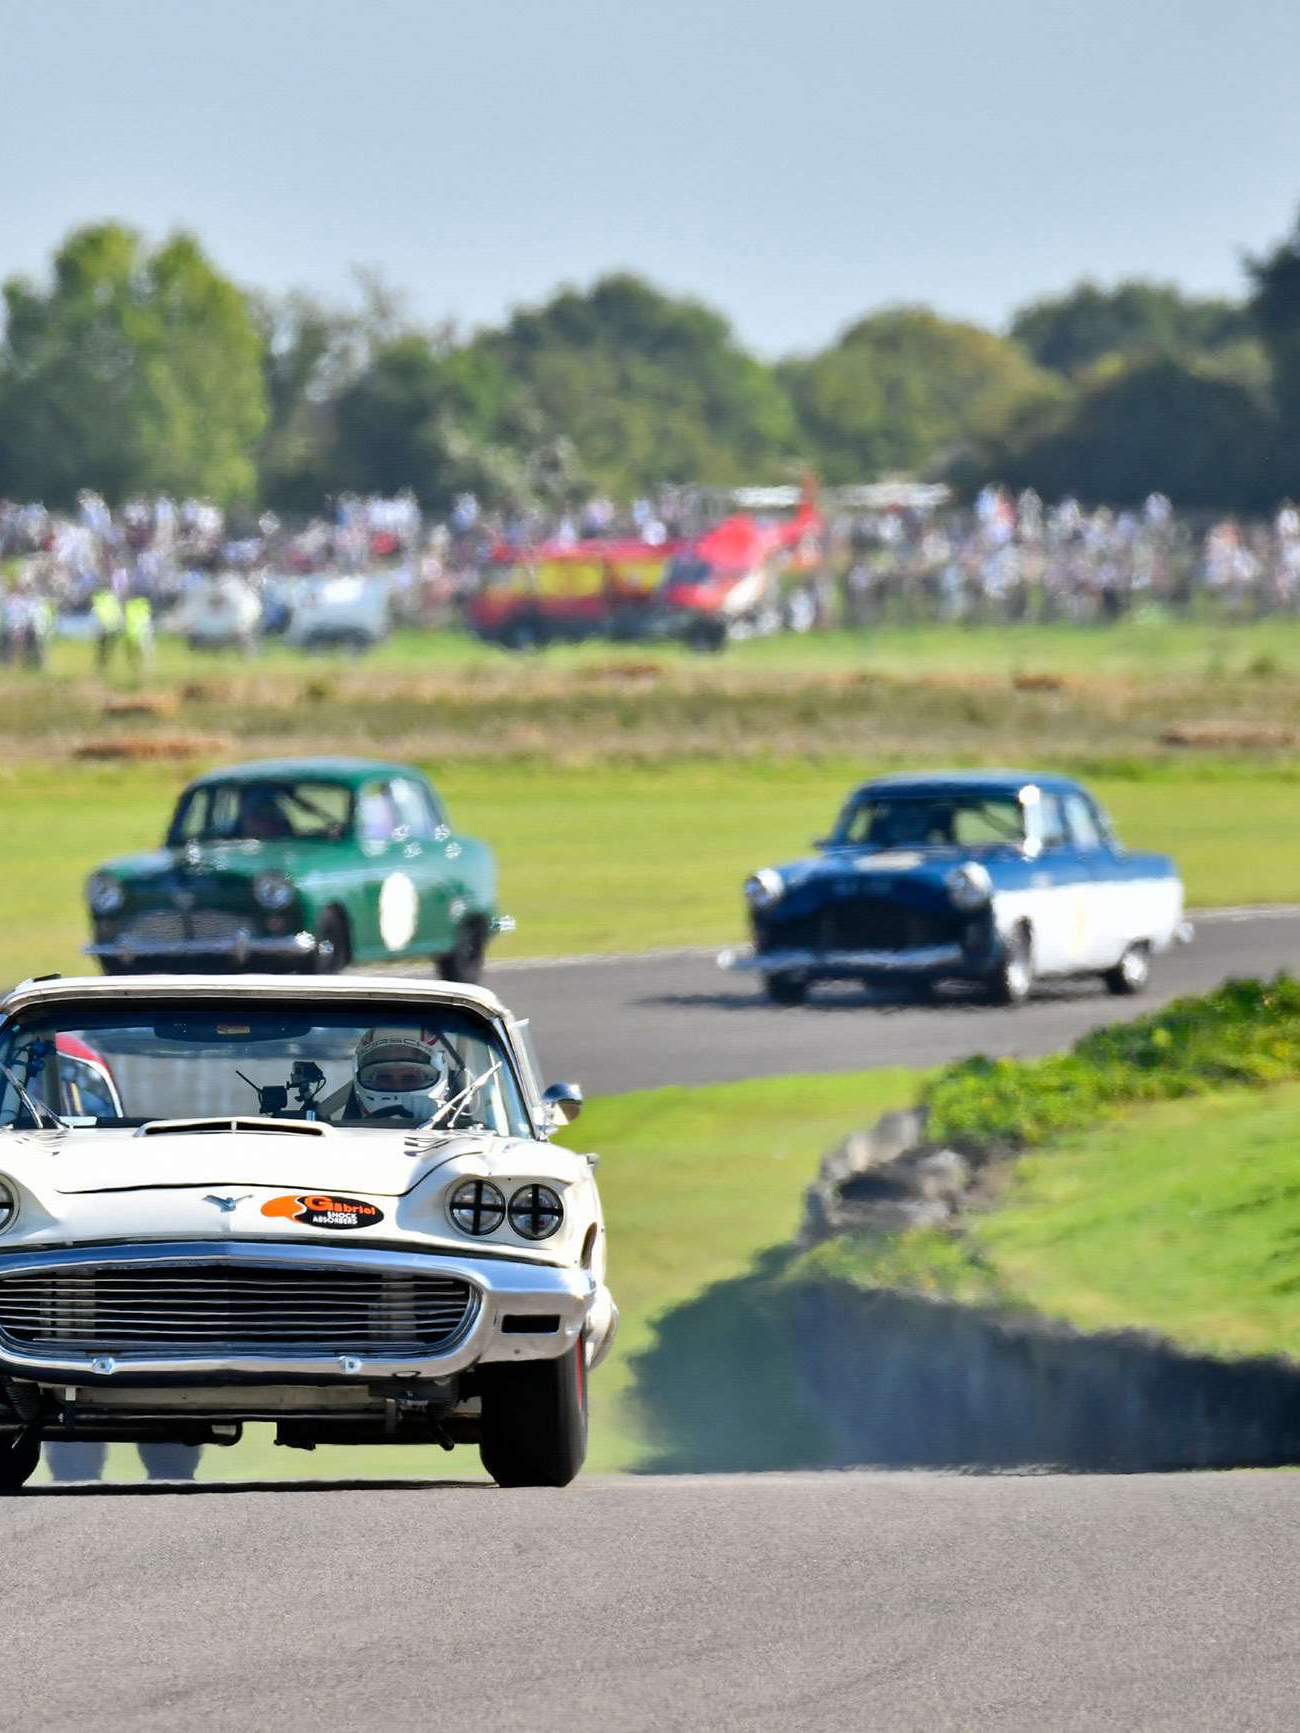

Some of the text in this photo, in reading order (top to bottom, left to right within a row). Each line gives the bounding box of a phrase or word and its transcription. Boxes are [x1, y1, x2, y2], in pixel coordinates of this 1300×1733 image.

[304, 1196, 375, 1215] Gabriel
[312, 1215, 358, 1225] ABSORBERS
[327, 1211, 357, 1219] SHOCK
